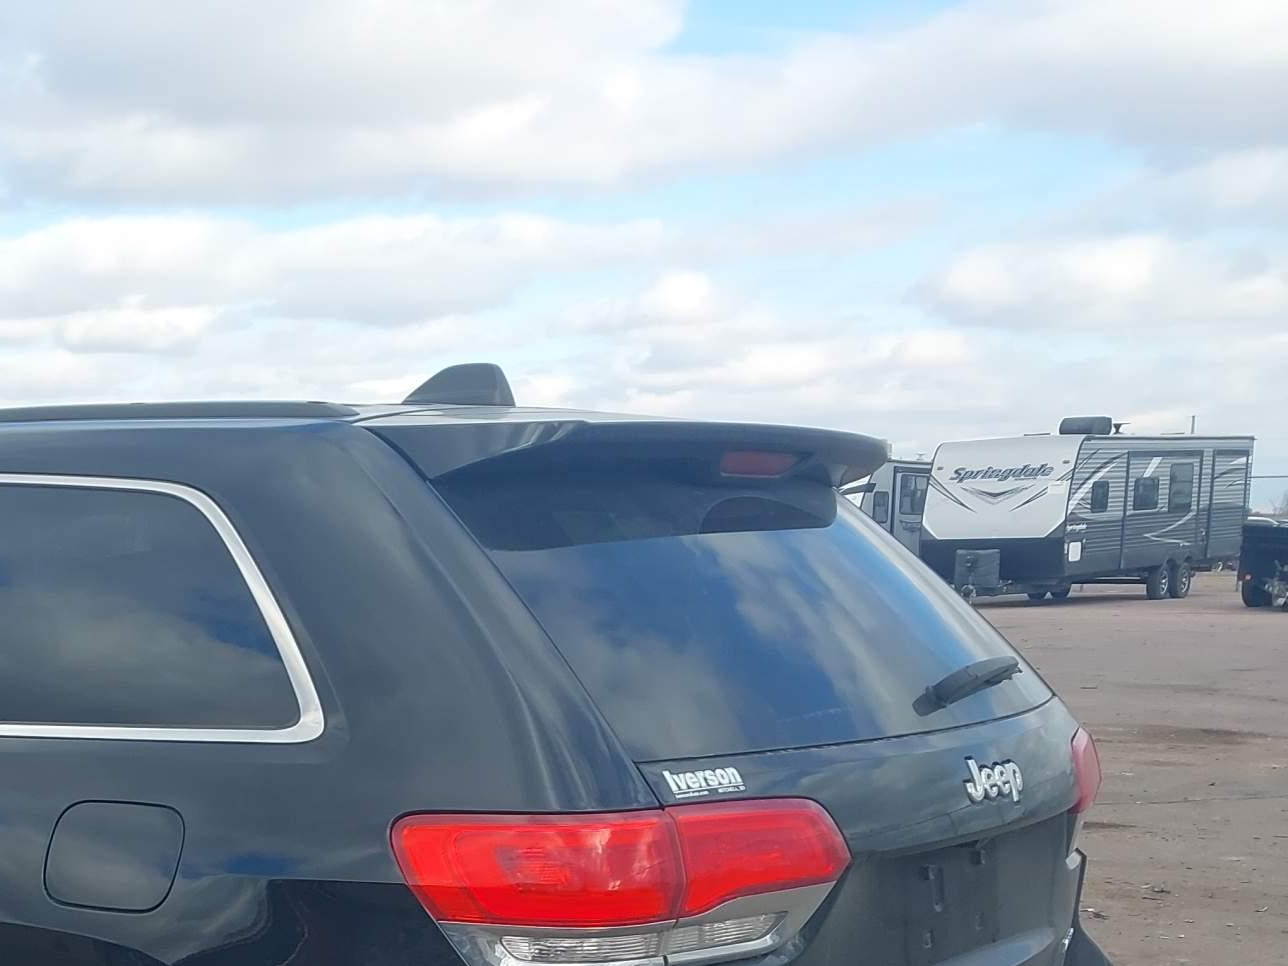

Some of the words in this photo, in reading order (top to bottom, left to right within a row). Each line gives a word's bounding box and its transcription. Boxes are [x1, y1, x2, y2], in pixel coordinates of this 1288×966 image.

[949, 463, 1054, 483] Springdale
[662, 767, 743, 791] Iverson
[963, 758, 1024, 802] Jeep
